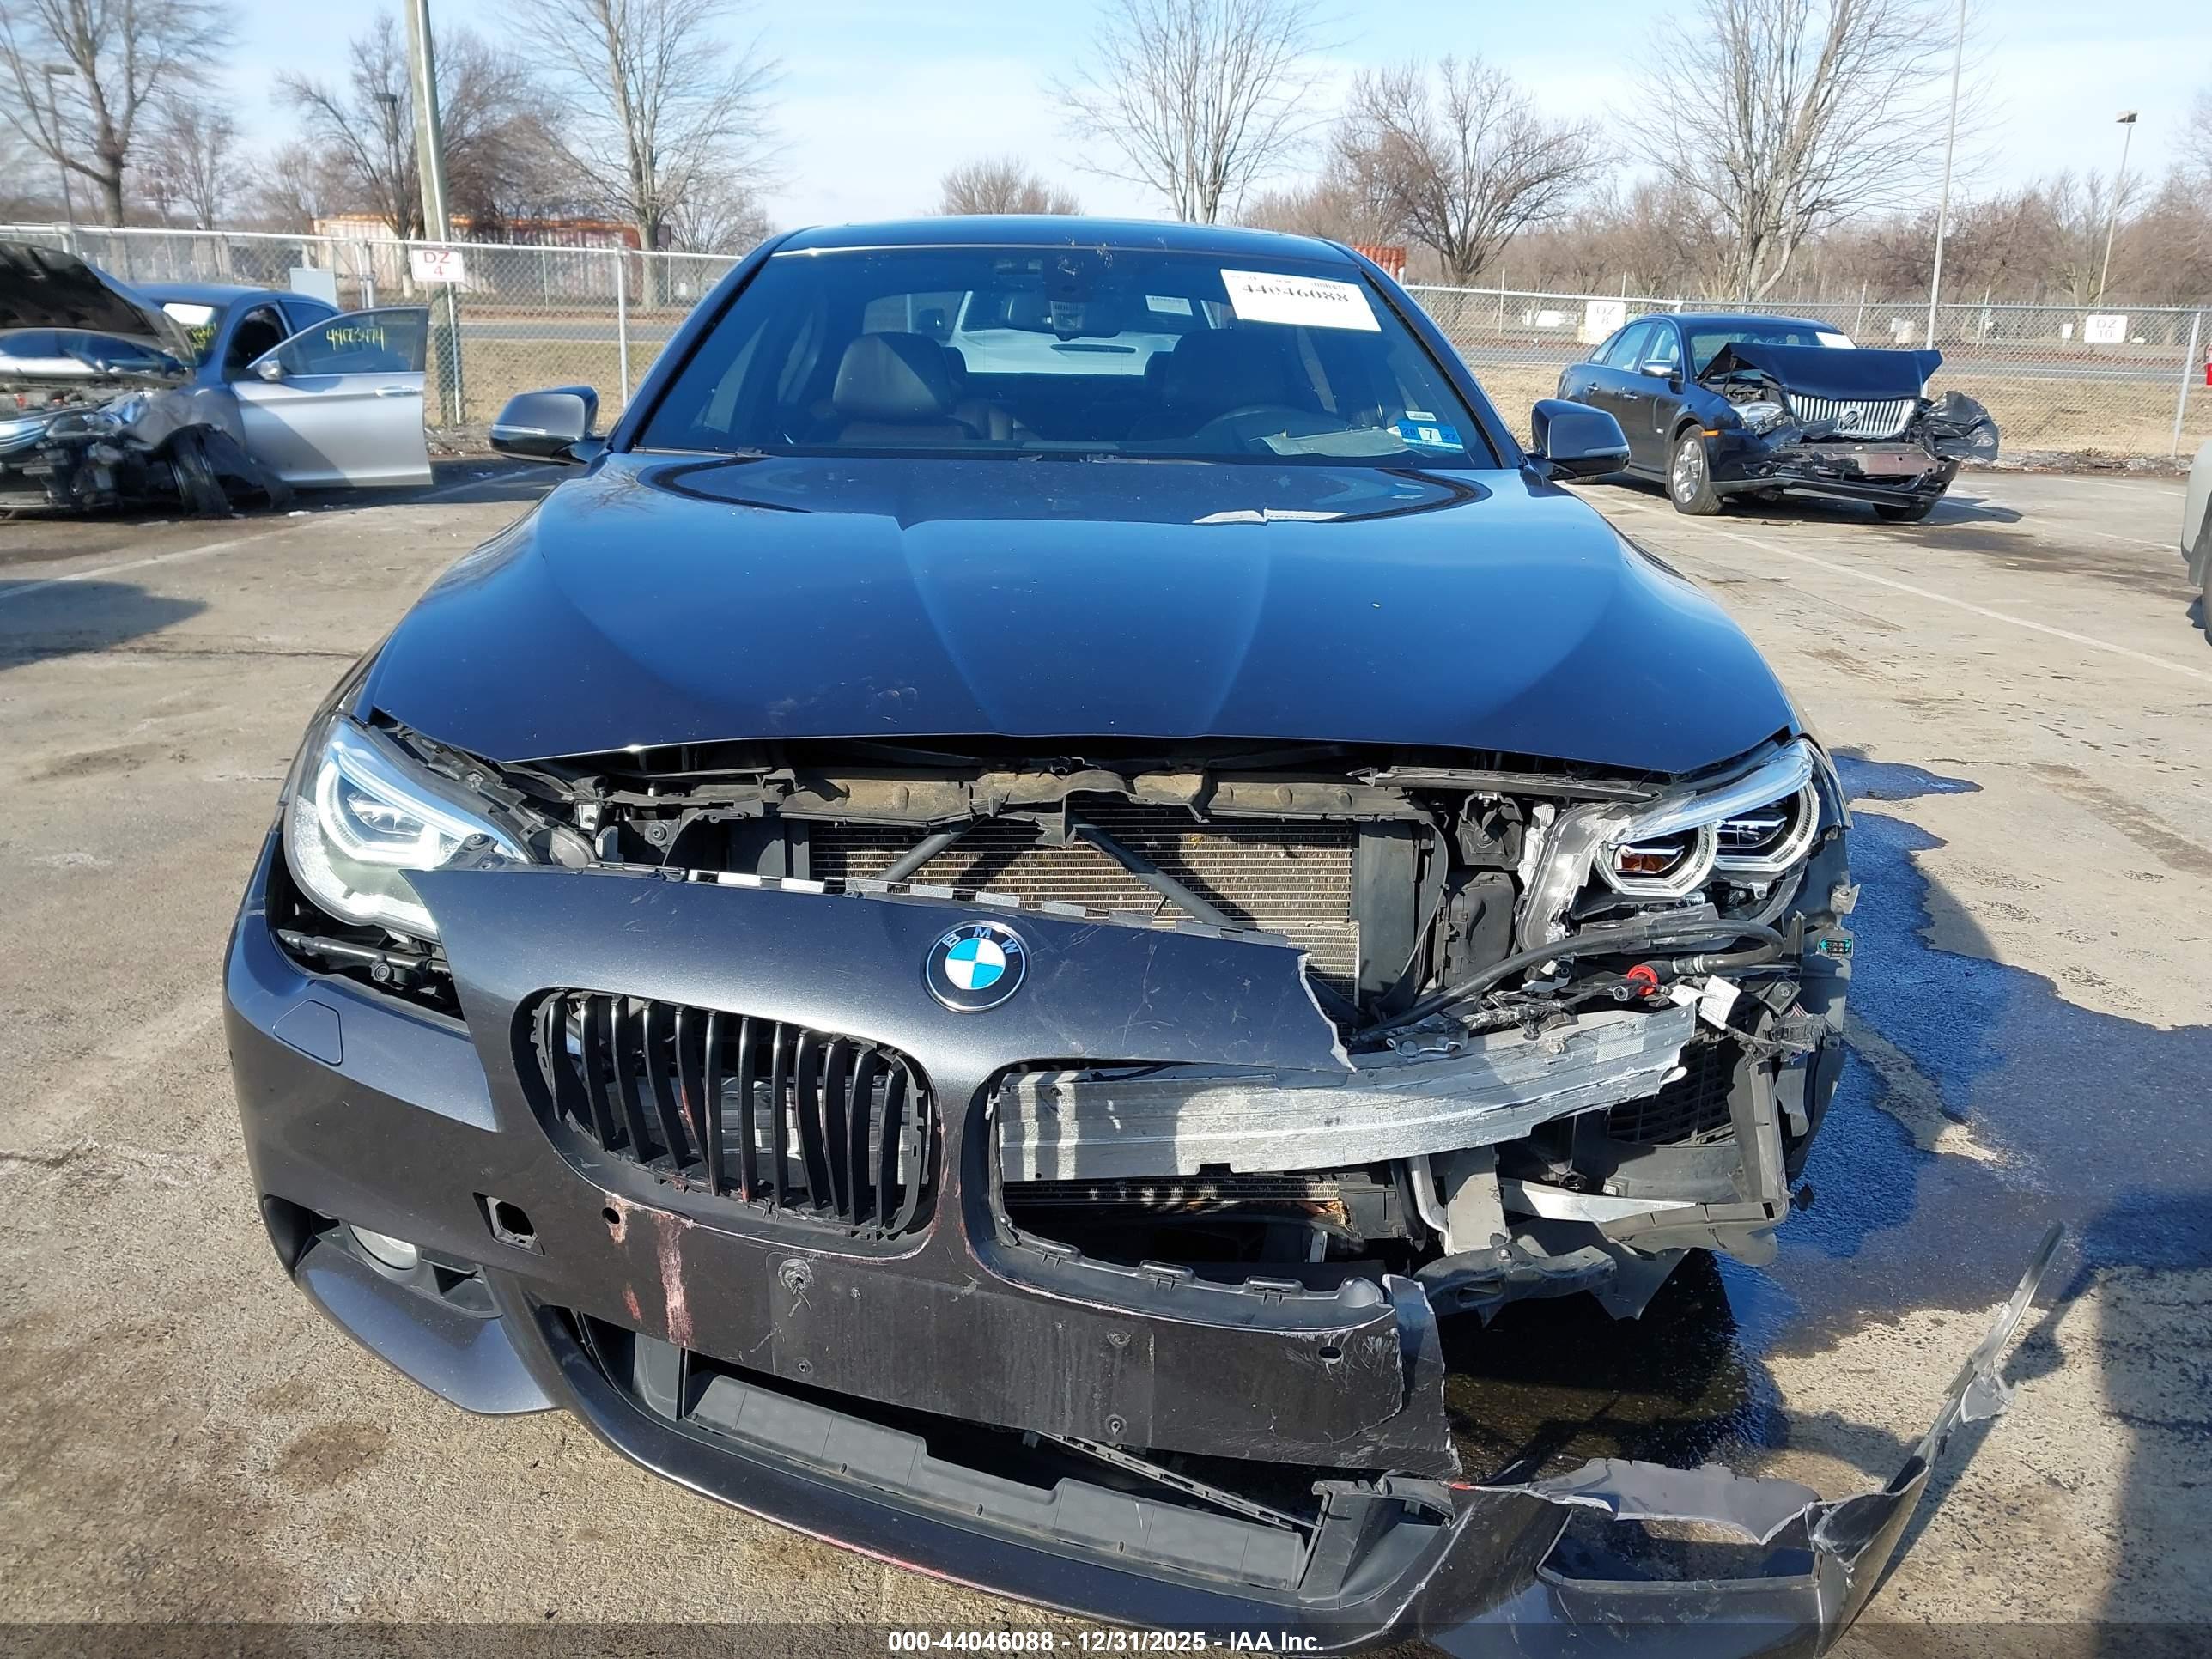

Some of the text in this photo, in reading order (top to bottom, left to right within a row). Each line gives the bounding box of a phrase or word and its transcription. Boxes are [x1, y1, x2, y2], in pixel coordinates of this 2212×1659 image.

[424, 251, 451, 264] DZ
[434, 265, 443, 276] 4
[1243, 284, 1348, 302] 44046088
[2096, 319, 2116, 329] DZ
[1425, 429, 1433, 440] 7
[941, 927, 1020, 955] BMW
